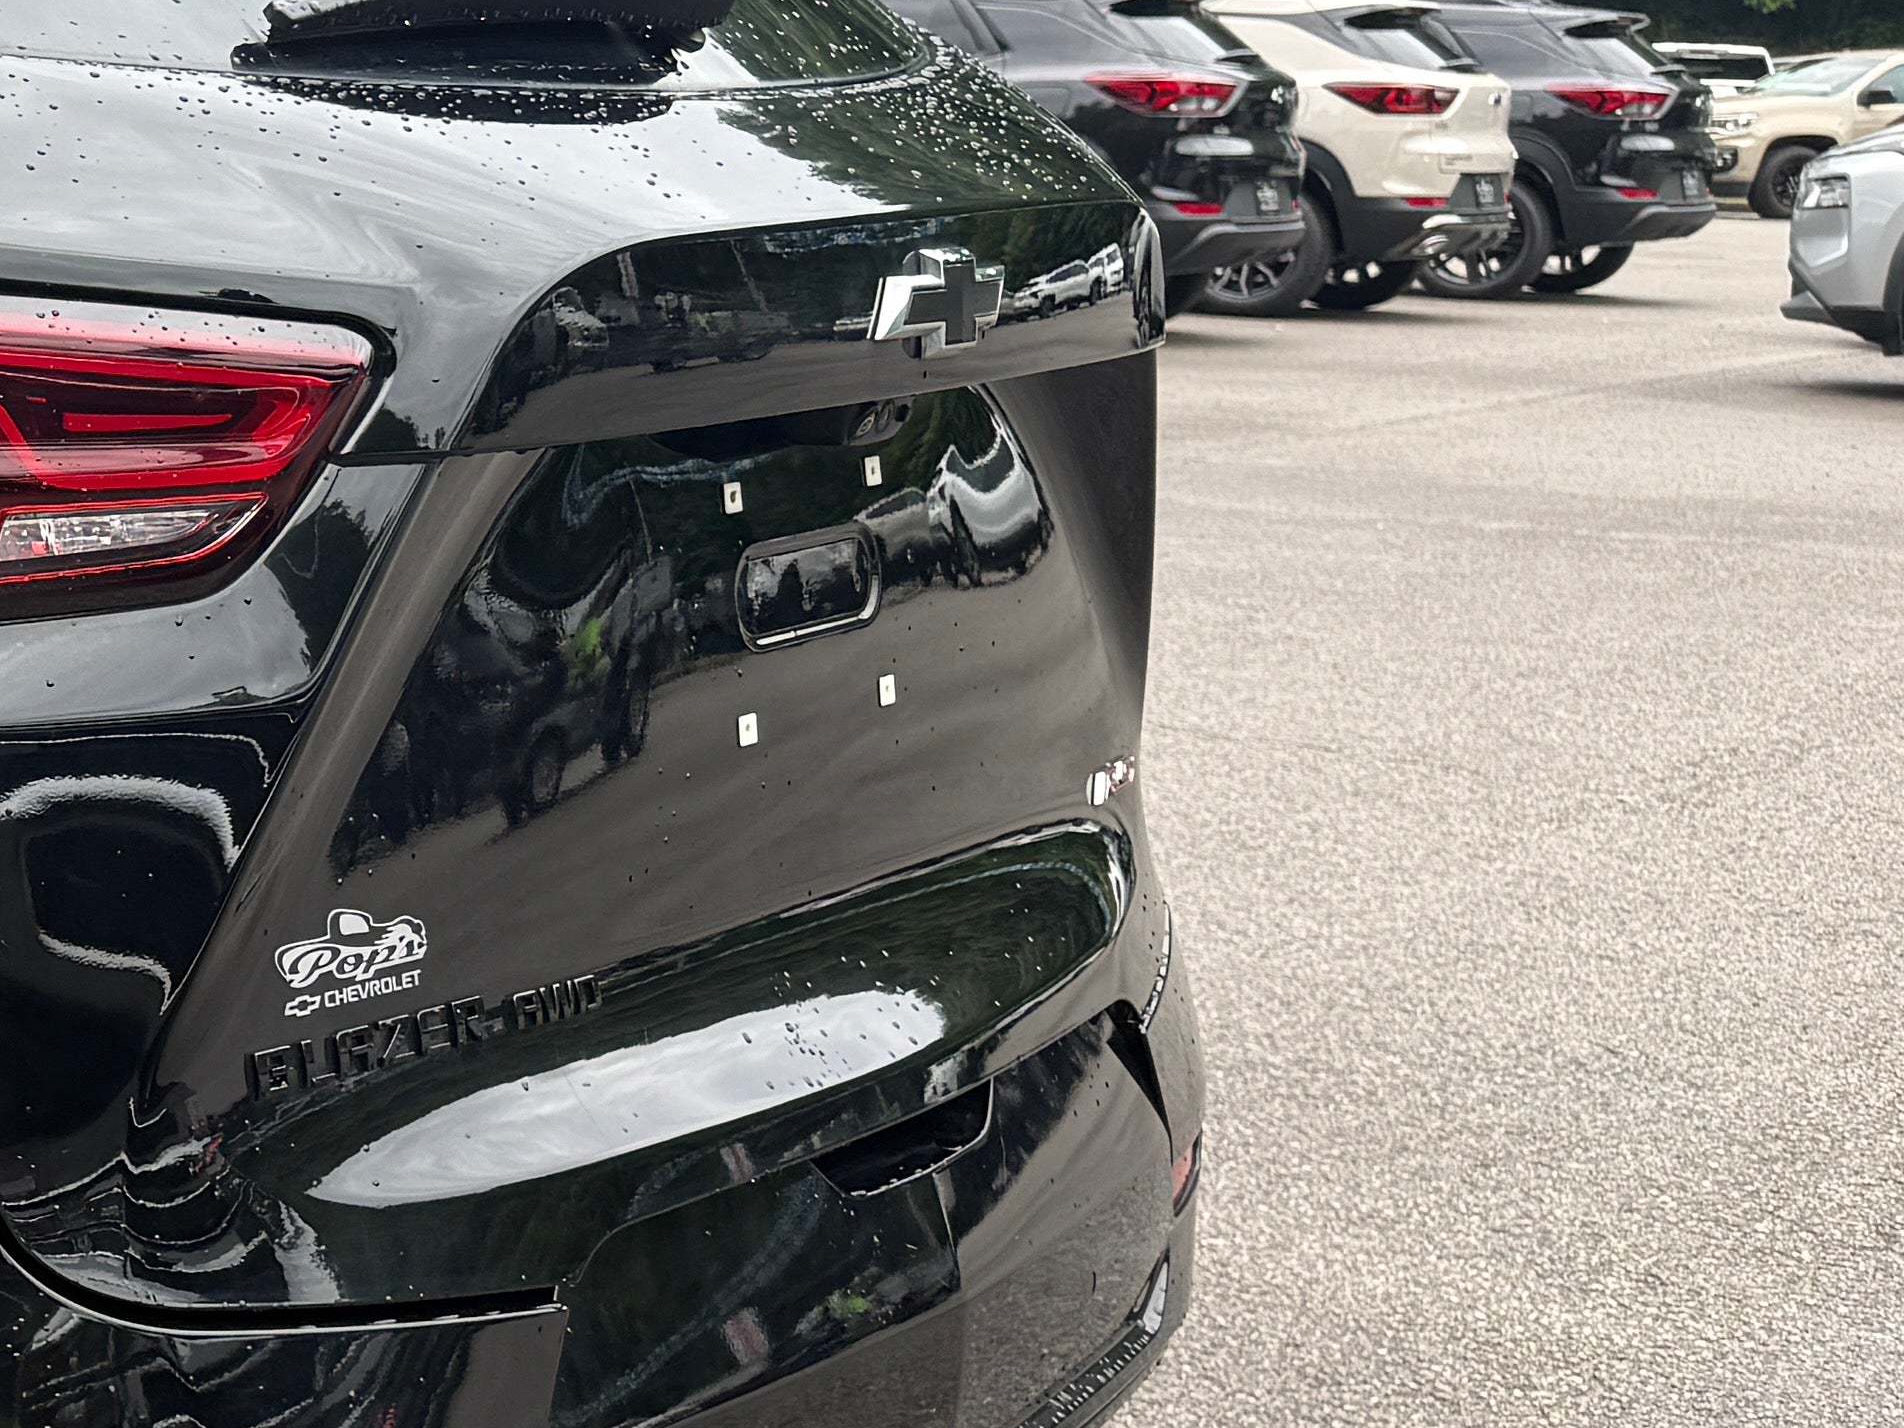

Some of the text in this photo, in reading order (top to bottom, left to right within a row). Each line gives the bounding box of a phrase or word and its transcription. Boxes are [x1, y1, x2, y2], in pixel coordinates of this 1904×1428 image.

[324, 970, 422, 1008] CHEVROLET
[254, 974, 603, 1098] BLAZER AWD
